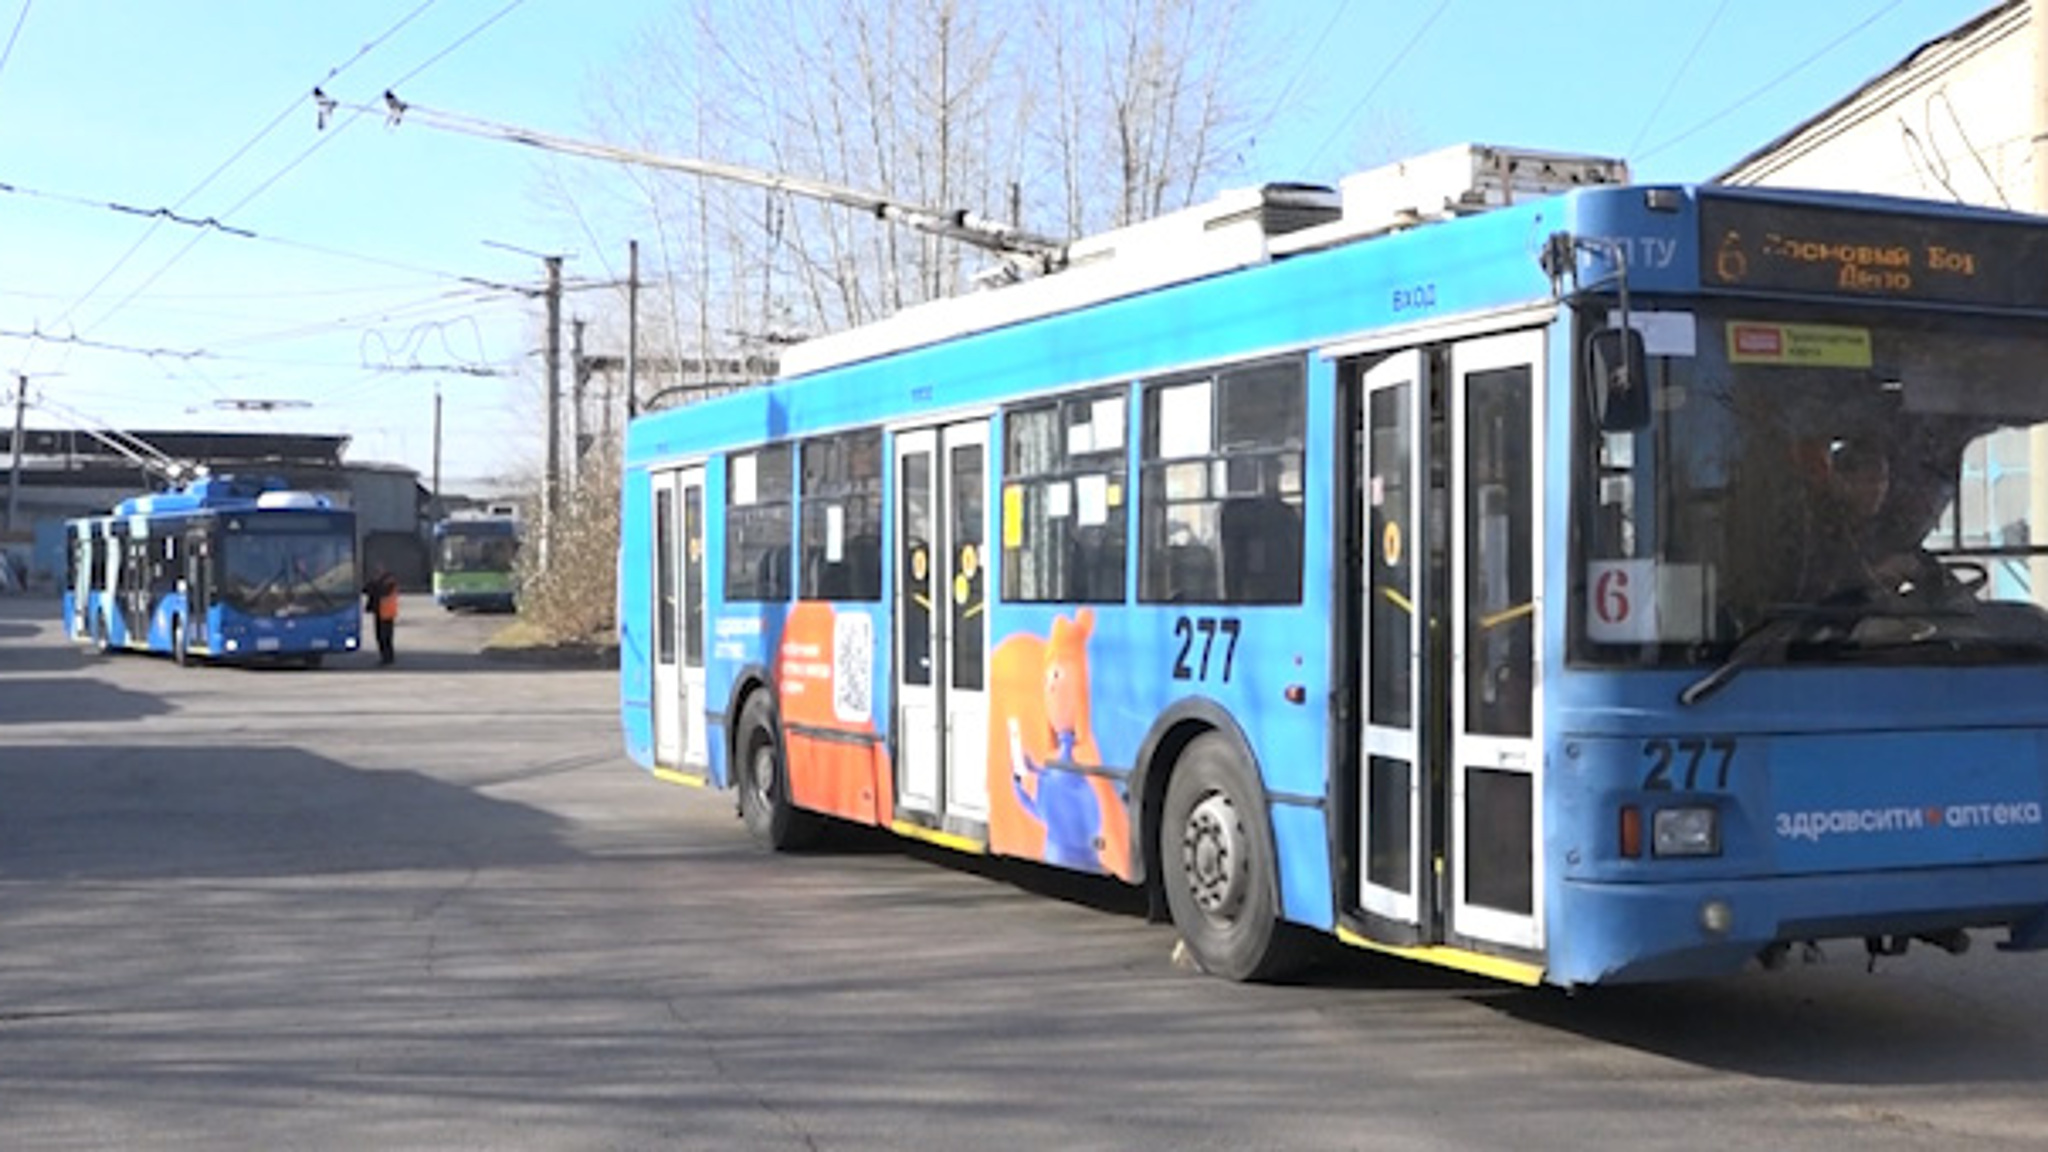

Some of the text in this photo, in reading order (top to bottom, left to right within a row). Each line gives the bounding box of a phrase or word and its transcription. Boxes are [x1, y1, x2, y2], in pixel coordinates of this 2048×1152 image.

[1596, 569, 1629, 624] 6
[1172, 615, 1242, 684] 277
[1642, 733, 1737, 792] 277
[1775, 802, 2042, 843] здравсити аптека
